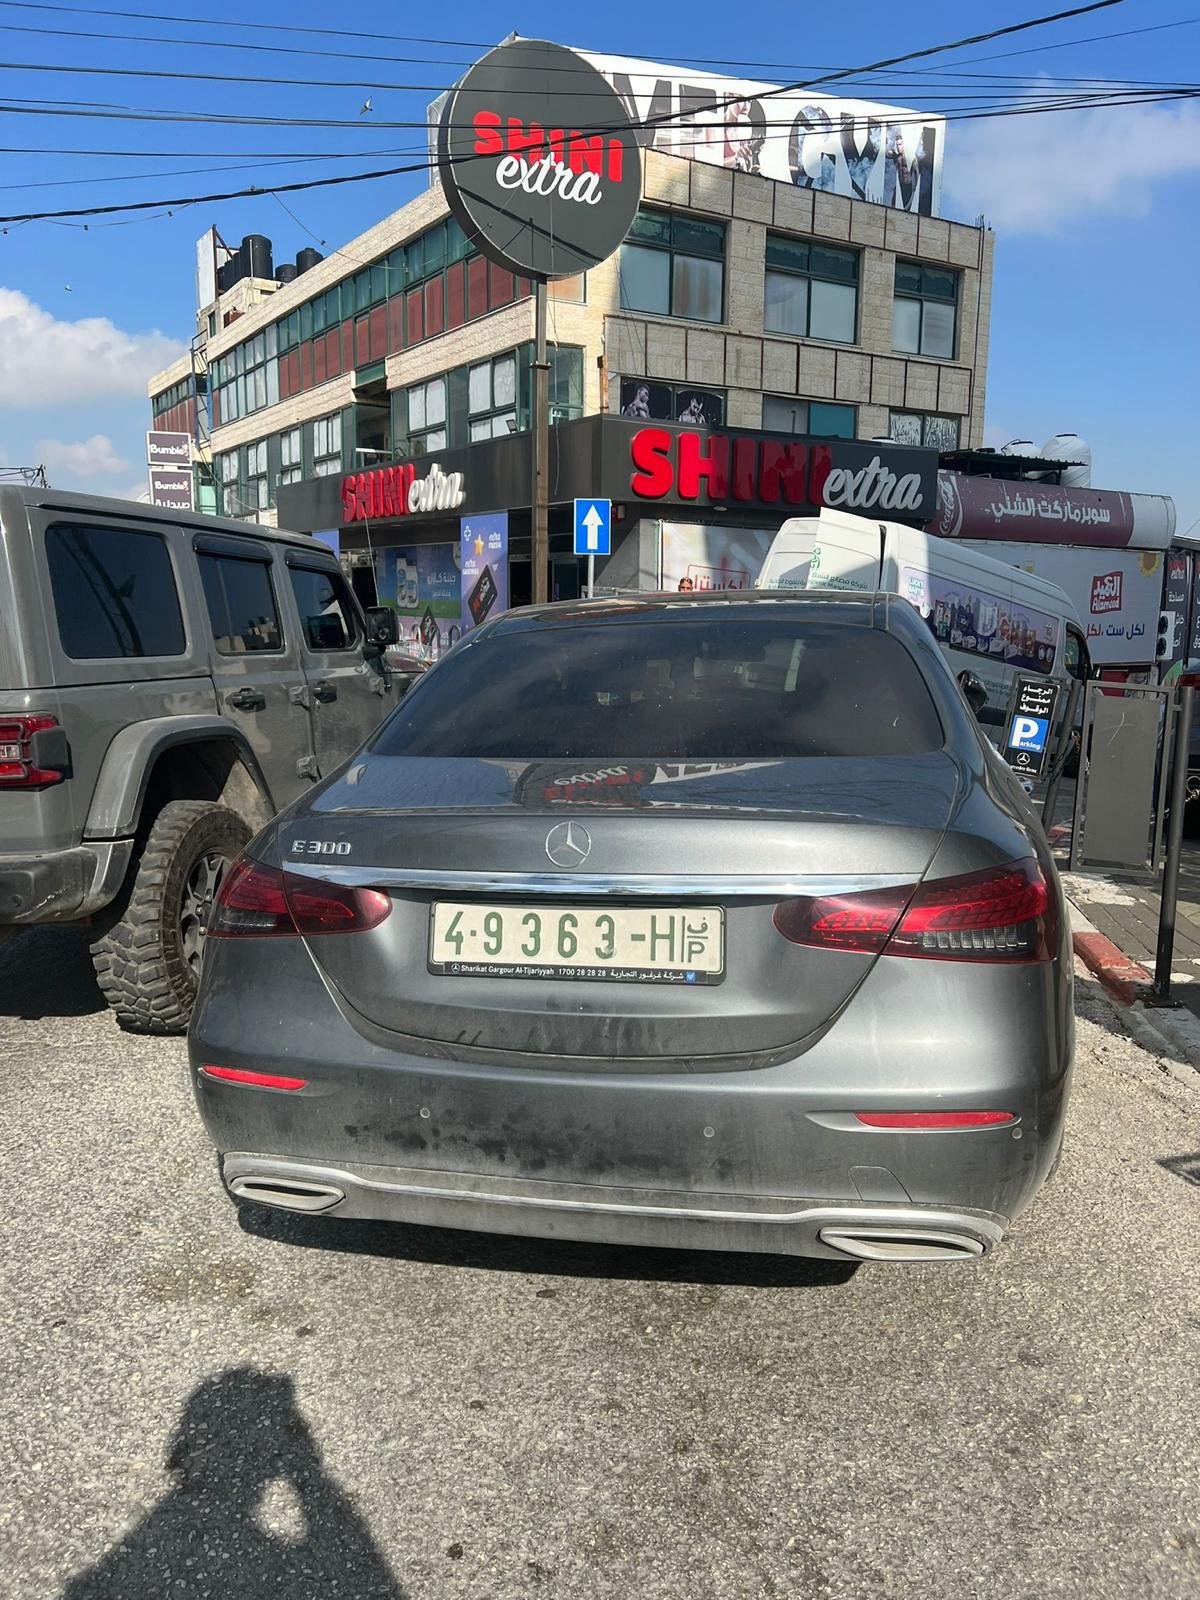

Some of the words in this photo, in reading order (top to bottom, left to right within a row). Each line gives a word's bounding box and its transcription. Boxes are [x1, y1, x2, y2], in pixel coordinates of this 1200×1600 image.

[472, 110, 624, 183] SHINI
[788, 104, 936, 217] GYM
[495, 151, 603, 205] extra
[342, 463, 415, 522] SHINI
[408, 462, 464, 513] extra
[630, 427, 832, 507] SHINI
[822, 455, 923, 511] extra
[460, 965, 488, 973] Sharikat
[488, 966, 514, 975] Gargour
[558, 968, 575, 976] 1700
[576, 968, 586, 976] 28
[587, 969, 596, 977] 28
[597, 969, 607, 977] 28
[610, 968, 638, 979] التجارية
[663, 971, 684, 980] شركة
